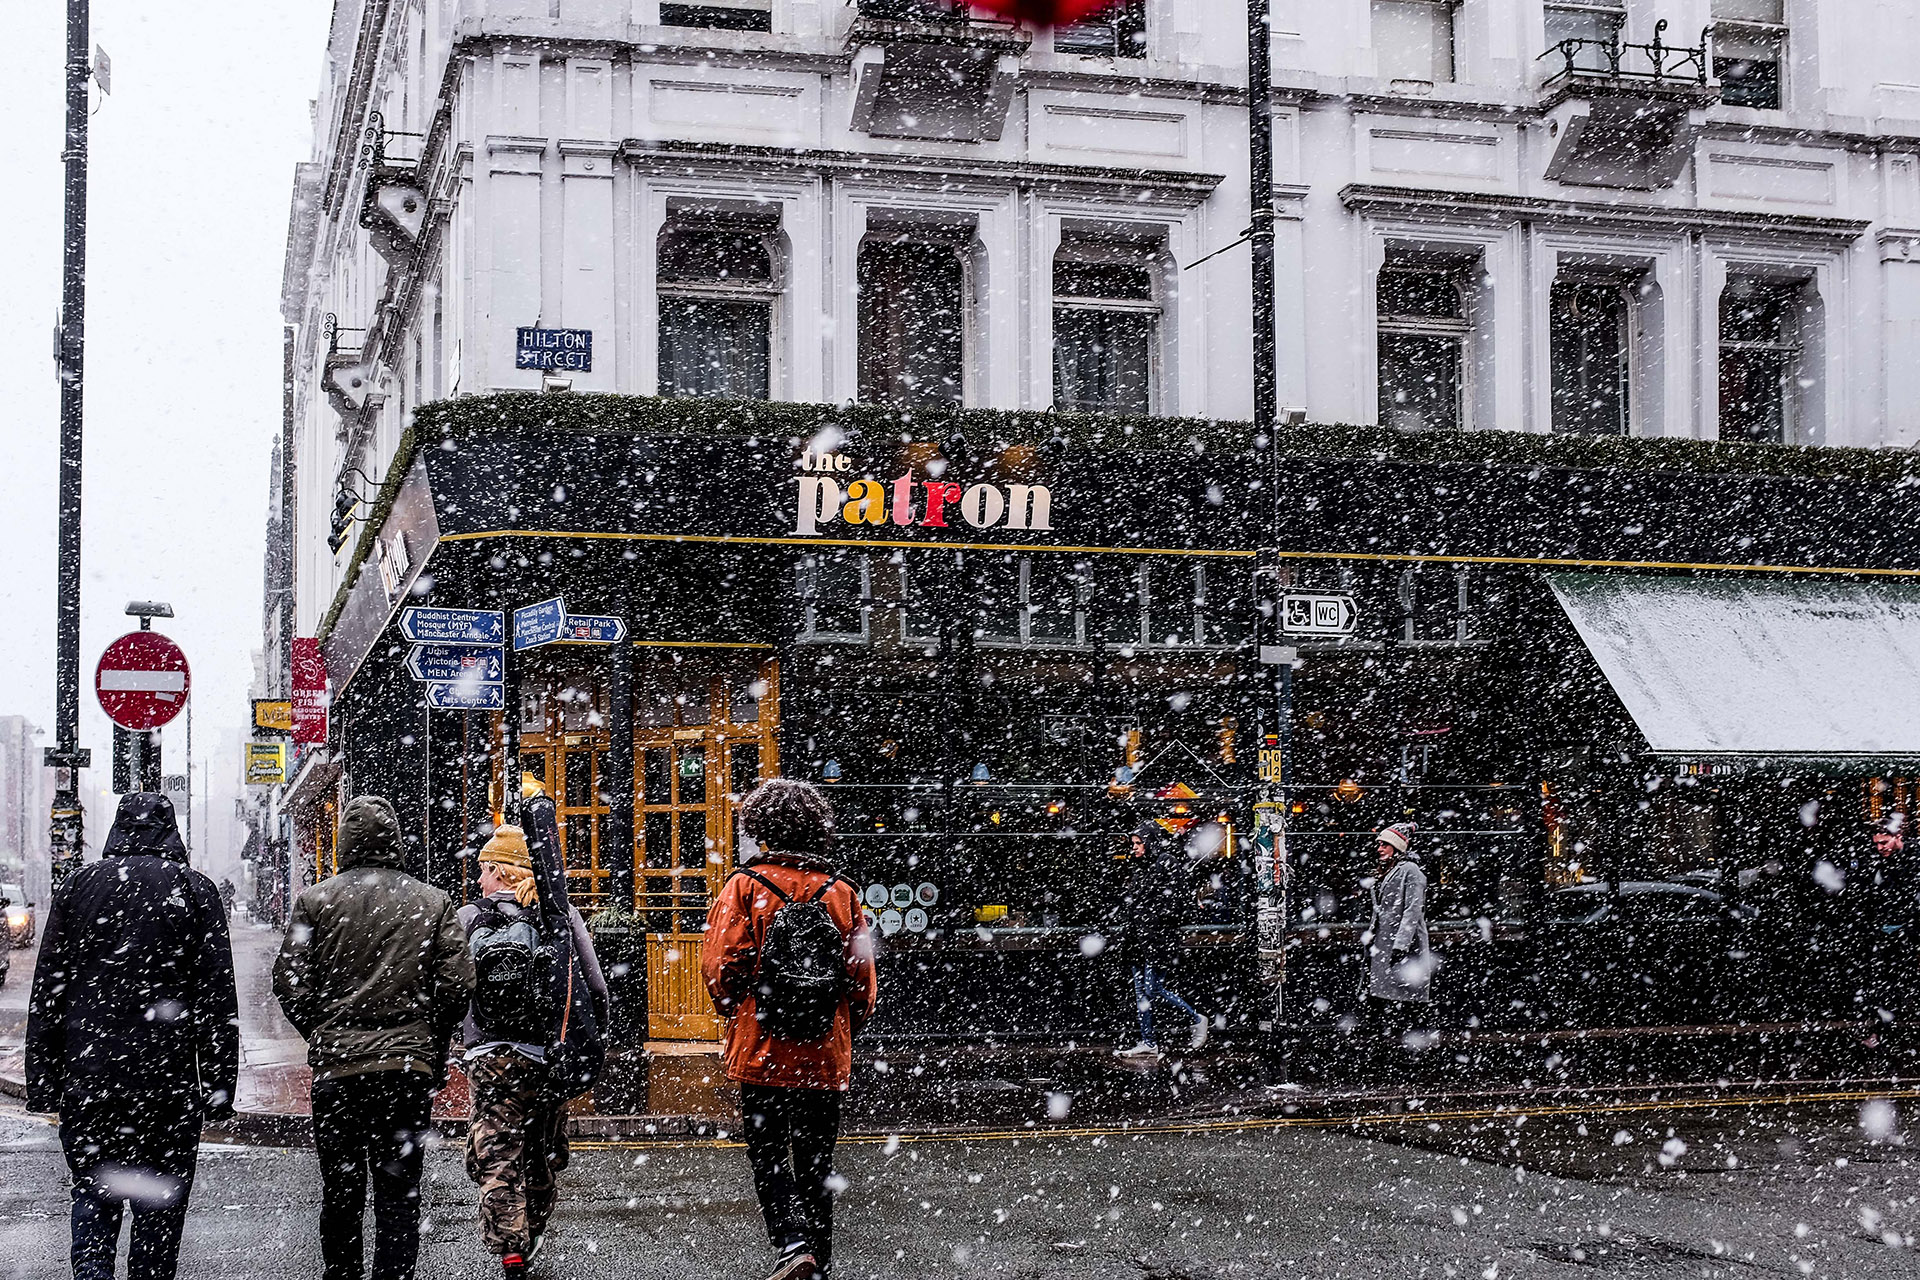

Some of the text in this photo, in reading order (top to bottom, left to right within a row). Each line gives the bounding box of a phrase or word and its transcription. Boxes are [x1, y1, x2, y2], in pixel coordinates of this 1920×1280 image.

[524, 332, 585, 348] HILTON
[520, 350, 587, 368] STREET
[801, 443, 852, 471] the
[789, 467, 1055, 536] patron
[417, 611, 476, 621] Buddhist Centre
[1318, 606, 1337, 621] WC
[417, 621, 446, 629] Mosque
[569, 618, 611, 628] Retail Park
[417, 629, 490, 639] Manchester Arndale
[427, 647, 449, 655] Urbis
[427, 657, 460, 666] Victoria
[427, 669, 448, 677] MEN
[292, 689, 325, 698] GREEN
[461, 696, 488, 705] Centre
[1273, 766, 1280, 776] 2
[1679, 762, 1732, 777] patron
[488, 970, 523, 981] adidas
